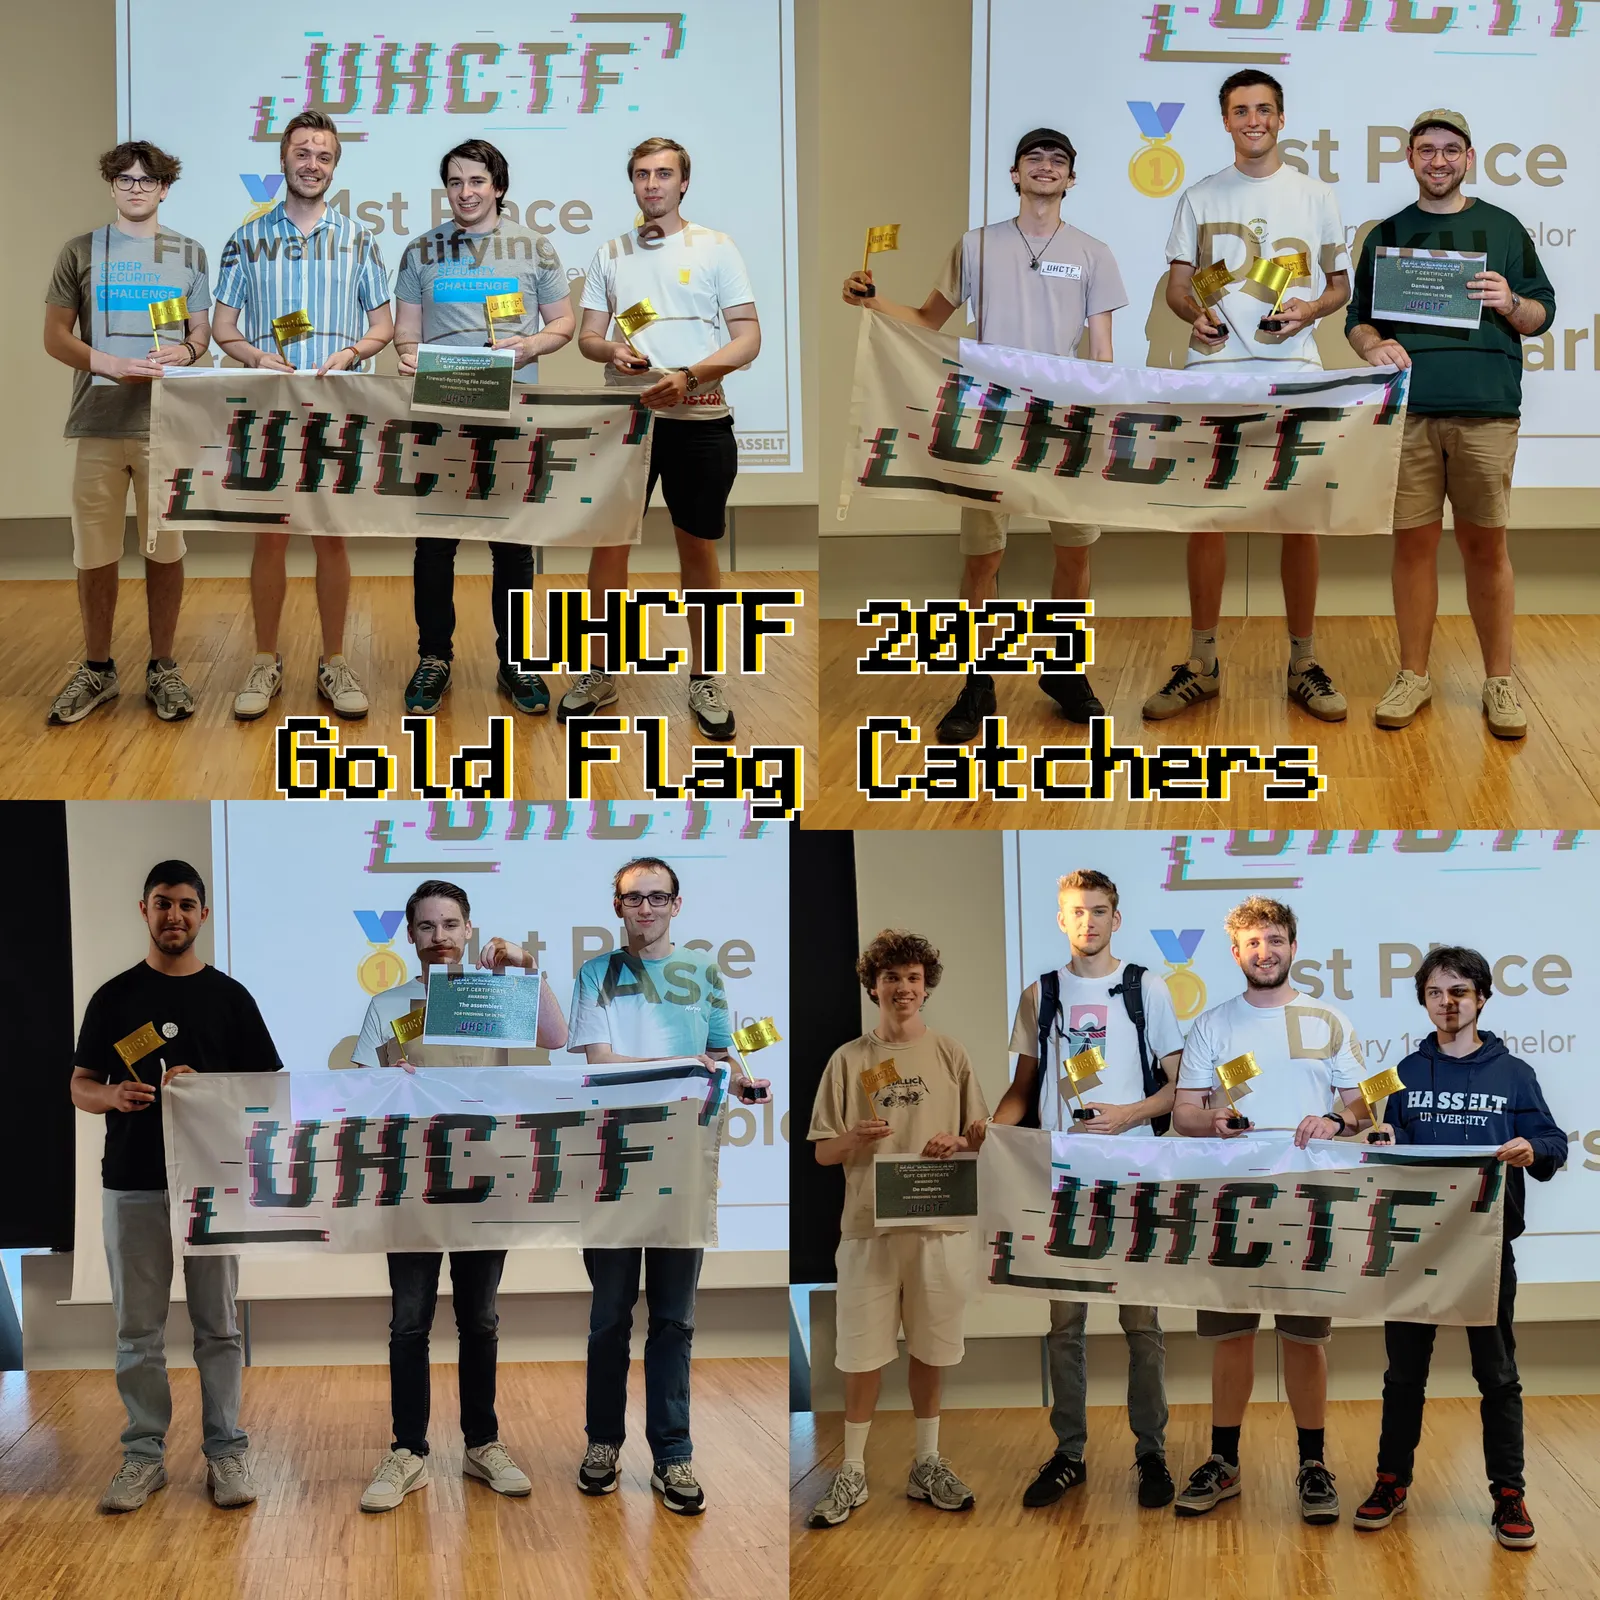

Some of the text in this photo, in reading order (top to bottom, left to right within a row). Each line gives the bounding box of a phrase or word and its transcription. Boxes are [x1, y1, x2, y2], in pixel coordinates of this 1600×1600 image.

[303, 42, 635, 115] UHCTF
[327, 188, 410, 236] 1st
[101, 261, 142, 272] CYBER
[437, 265, 496, 277] SECURITY
[1046, 264, 1076, 274] UHCTF
[100, 272, 162, 283] SECURITY
[436, 281, 510, 291] CHALLENGE
[100, 288, 176, 299] CHALLENGE
[1409, 299, 1445, 309] UHCTF
[927, 373, 1345, 490] UHCTF
[222, 408, 592, 503] UHCTF
[460, 1021, 496, 1031] UHCTF
[1407, 1090, 1508, 1115] HASSELT
[1419, 1112, 1489, 1127] UNIVERSITY
[245, 1105, 670, 1208] UHCTF
[1044, 1174, 1455, 1277] UHCTF
